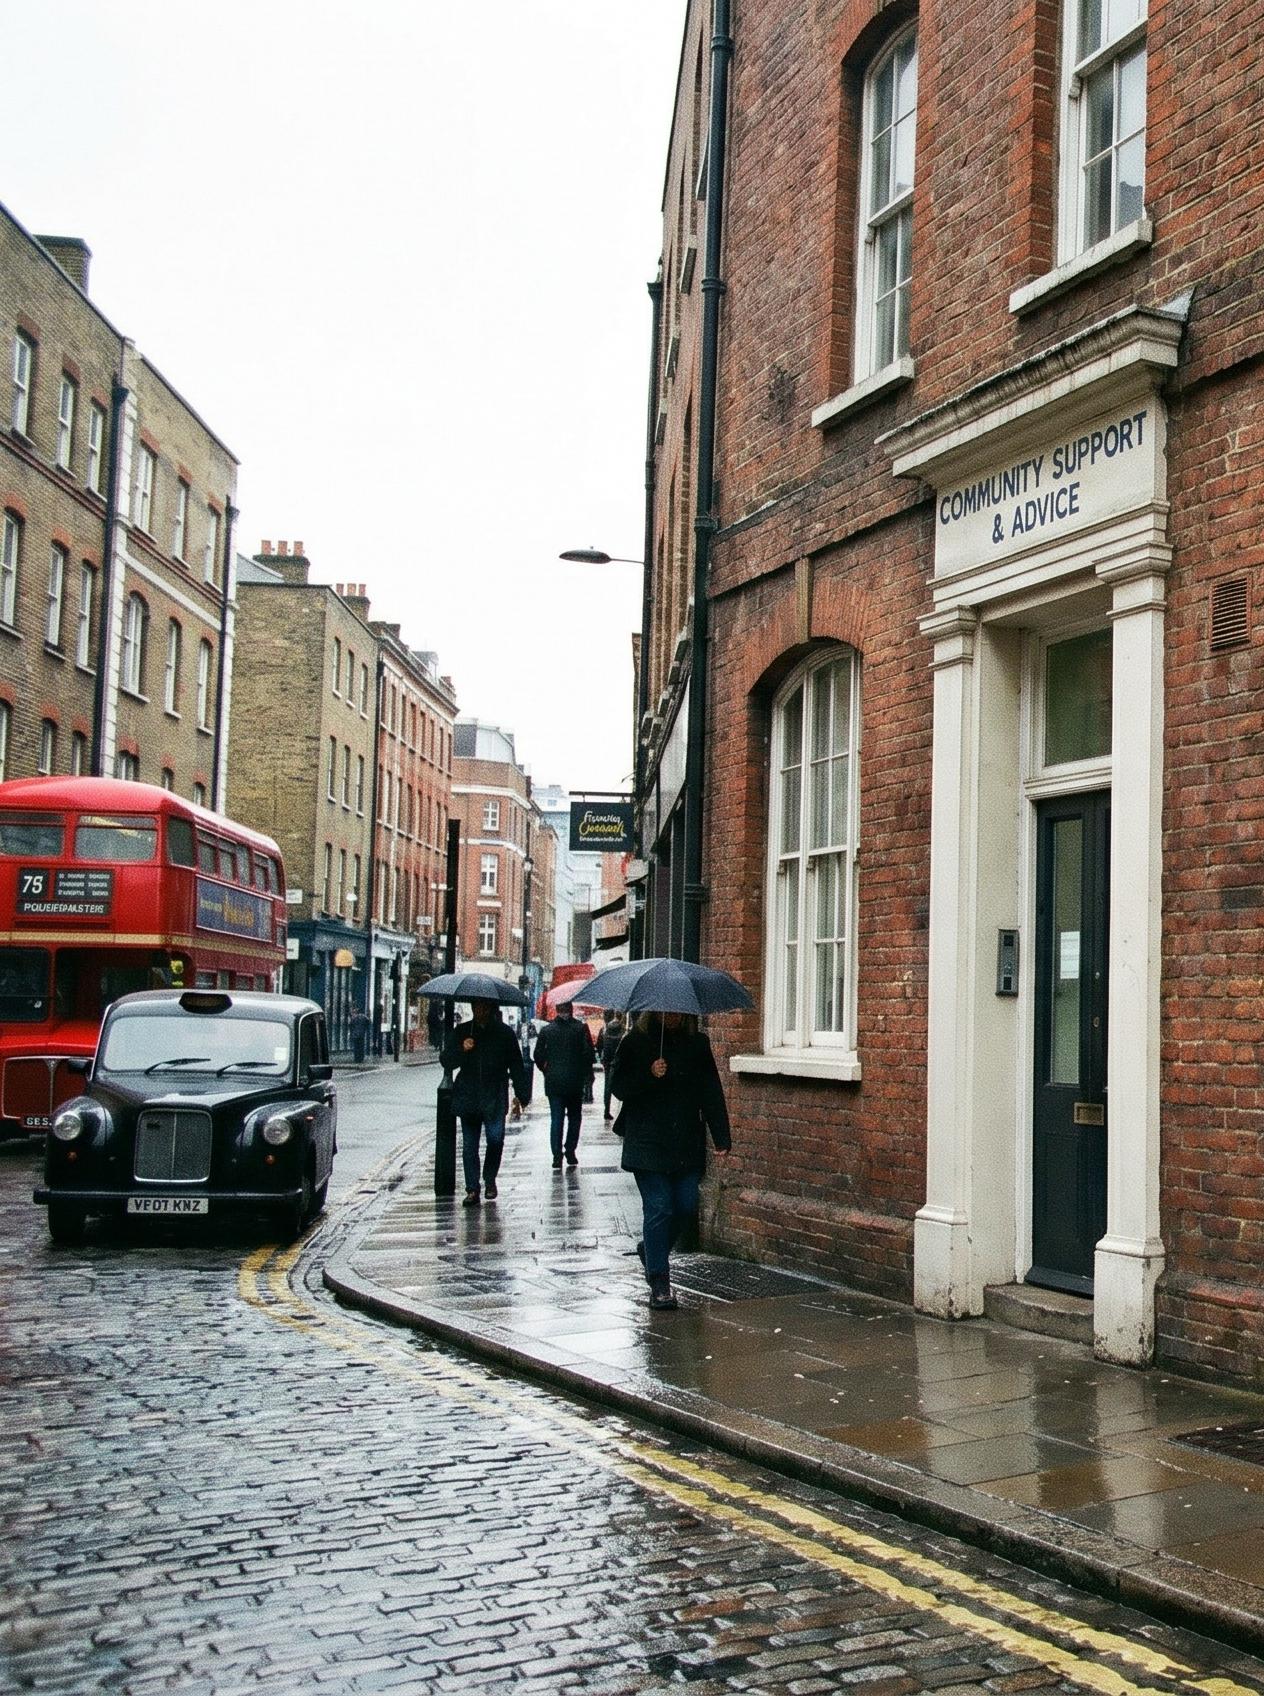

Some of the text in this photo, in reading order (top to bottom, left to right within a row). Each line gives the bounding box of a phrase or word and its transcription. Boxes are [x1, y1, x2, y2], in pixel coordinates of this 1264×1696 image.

[940, 410, 1147, 525] COMMUNITY SUPPORT
[991, 482, 1080, 544] & ADVICE
[22, 875, 44, 894] 75
[173, 1199, 201, 1212] KNZ
